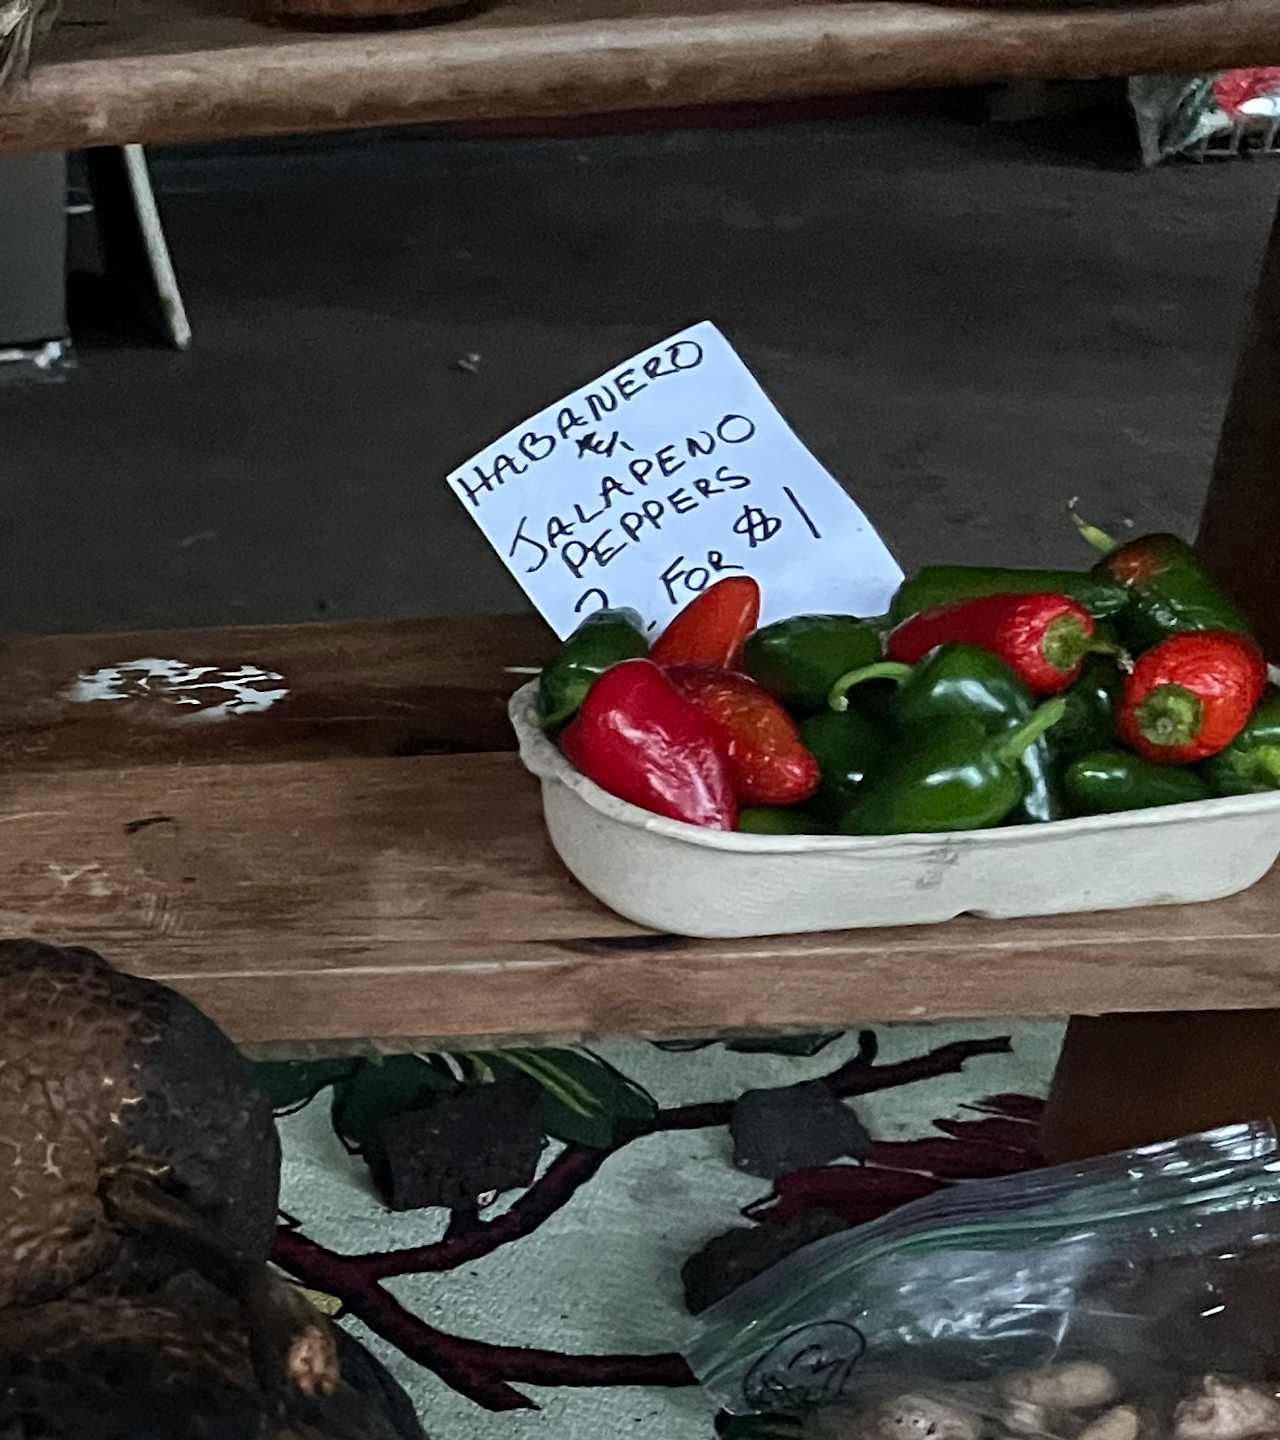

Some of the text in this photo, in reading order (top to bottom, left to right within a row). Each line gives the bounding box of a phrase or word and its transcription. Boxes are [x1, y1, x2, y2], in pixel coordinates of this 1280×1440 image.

[456, 339, 704, 507] HABANERO
[508, 413, 756, 573] JALAPENO
[560, 465, 751, 579] PEPPERS
[659, 550, 744, 604] FOR
